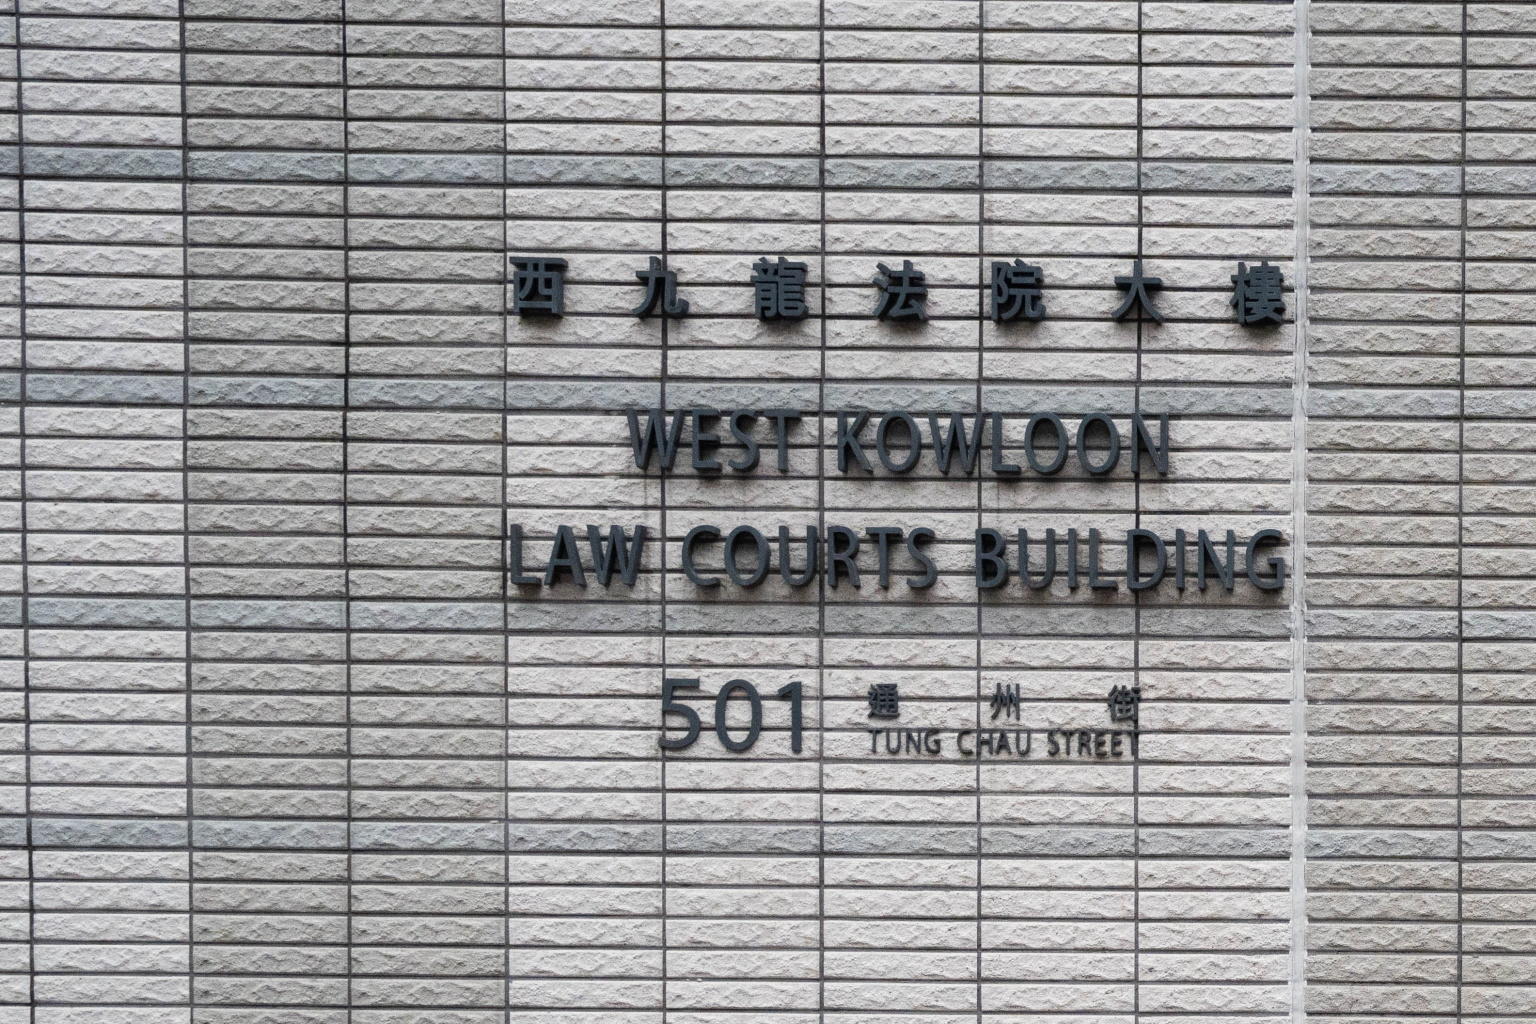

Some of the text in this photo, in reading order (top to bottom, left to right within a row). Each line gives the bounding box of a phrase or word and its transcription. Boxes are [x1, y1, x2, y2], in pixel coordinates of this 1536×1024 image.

[509, 256, 1285, 325] 西九龍法院大樓
[626, 408, 1169, 476] WEST KOWLOON
[510, 523, 1285, 591] LAW COURTS BUILDING
[658, 678, 803, 754] 501
[868, 683, 1140, 722] 通州街
[868, 729, 1138, 757] TUNG CHAU STREET
